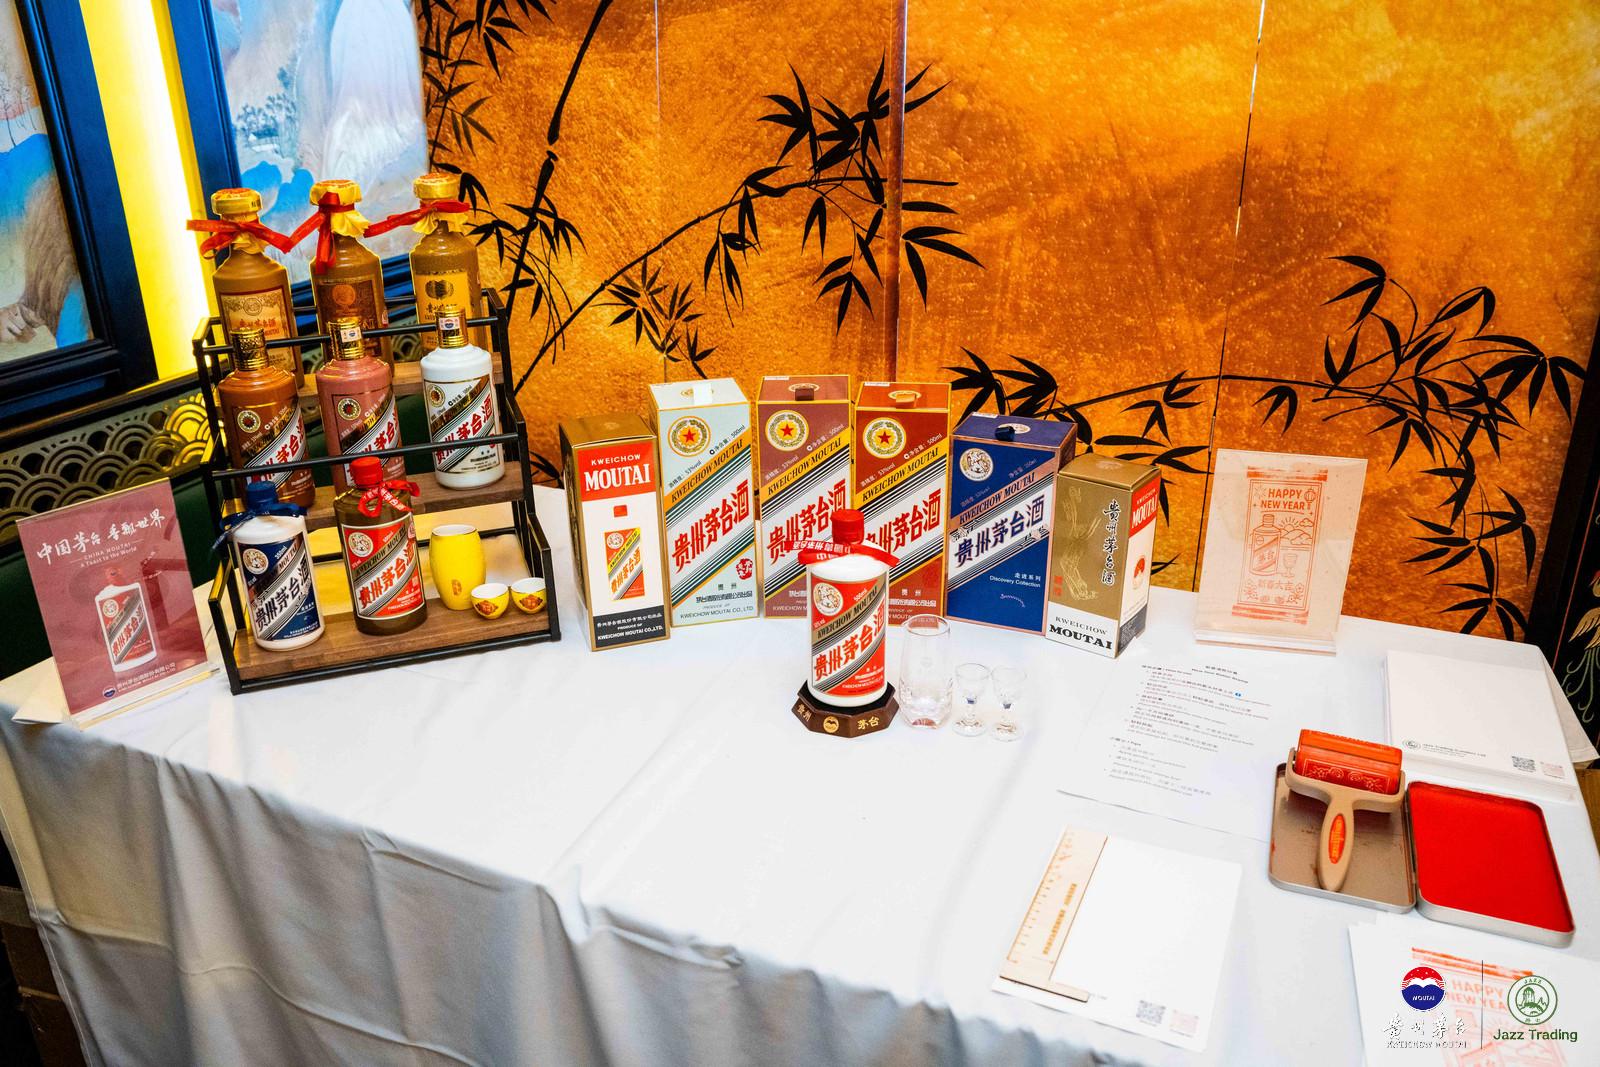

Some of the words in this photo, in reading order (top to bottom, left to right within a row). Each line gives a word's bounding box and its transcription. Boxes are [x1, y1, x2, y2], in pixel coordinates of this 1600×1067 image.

[591, 453, 641, 466] KWEICHOW
[671, 464, 713, 504] KWEICHOW
[713, 438, 743, 468] MOUTAI
[767, 457, 810, 496] KWEICHOW
[810, 437, 842, 466] MOUTAI
[862, 467, 907, 502] KWEICHOW
[907, 446, 940, 473] MOUTAI
[584, 463, 652, 492] MOUTAI
[1267, 487, 1303, 499] HAPPY
[960, 491, 1003, 525] KWEICHOW
[1003, 471, 1036, 499] MOUTAI
[1131, 494, 1158, 529] MOUTAI
[1260, 500, 1281, 509] NEW
[1282, 500, 1305, 510] YEAR
[671, 478, 750, 575] 贵州茅台酒
[954, 494, 1046, 569] 贵州茅台酒
[36, 531, 102, 566] 中国茅台
[359, 540, 417, 610] 贵州茅台酒
[989, 575, 1015, 585] Discovery
[1015, 579, 1041, 588] Collection
[255, 552, 310, 632] 贵州茅台酒
[710, 608, 732, 616] MOUTAI
[817, 609, 853, 640] KWEICHOW
[1055, 616, 1108, 636] KWEICHOW
[813, 594, 885, 682] 贵州茅台酒
[1049, 623, 1113, 650] MOUTAI
[857, 715, 880, 730] 茅台
[1451, 979, 1505, 1001] HAPPY
